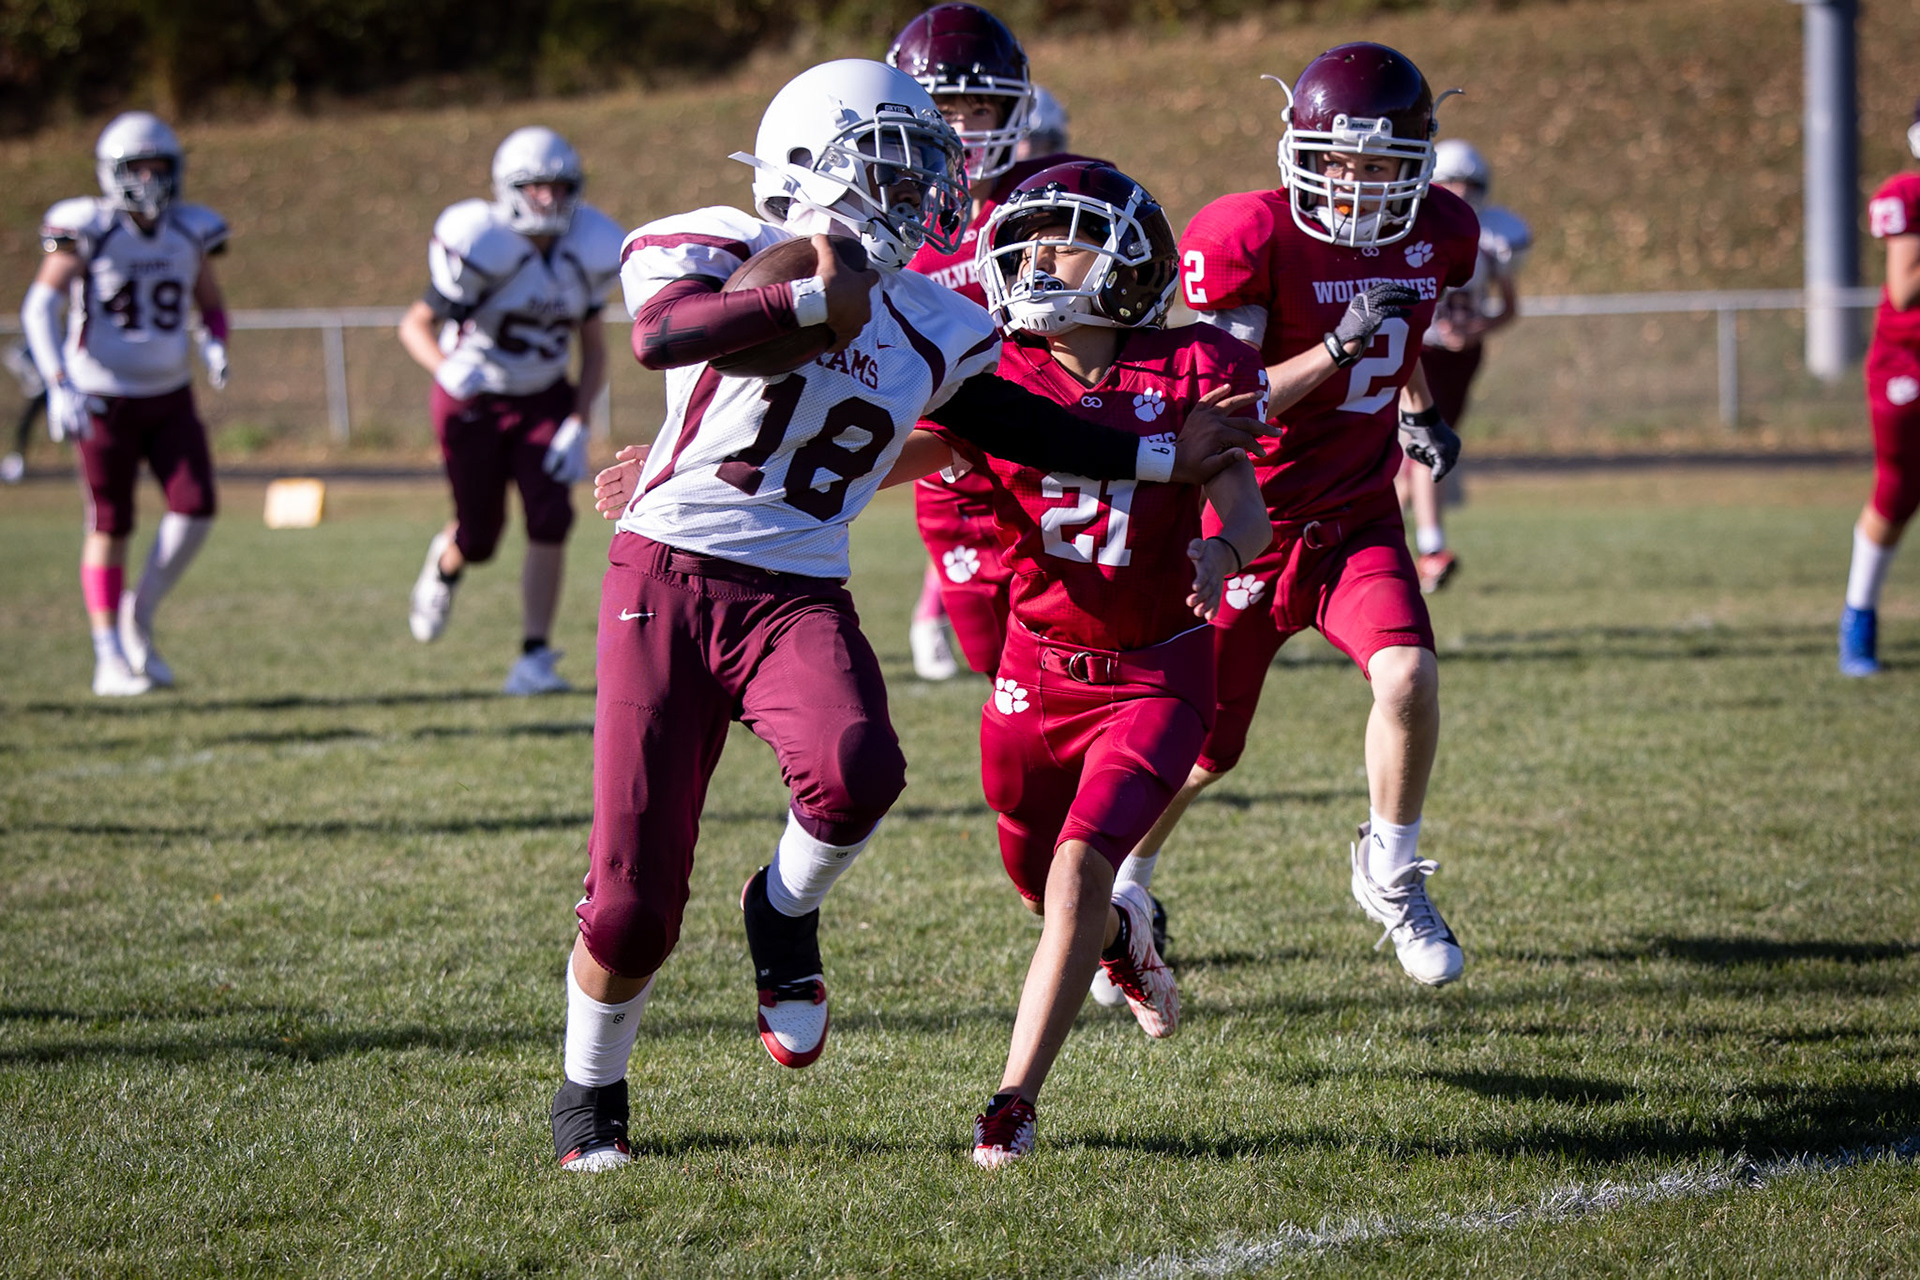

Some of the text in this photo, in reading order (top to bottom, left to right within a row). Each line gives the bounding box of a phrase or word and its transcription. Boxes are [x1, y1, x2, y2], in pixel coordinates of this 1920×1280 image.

[104, 279, 182, 333] 49
[1183, 249, 1208, 304] 2
[815, 348, 878, 390] AMS
[1336, 317, 1409, 414] 2
[715, 372, 895, 522] 18
[1041, 471, 1137, 567] 21
